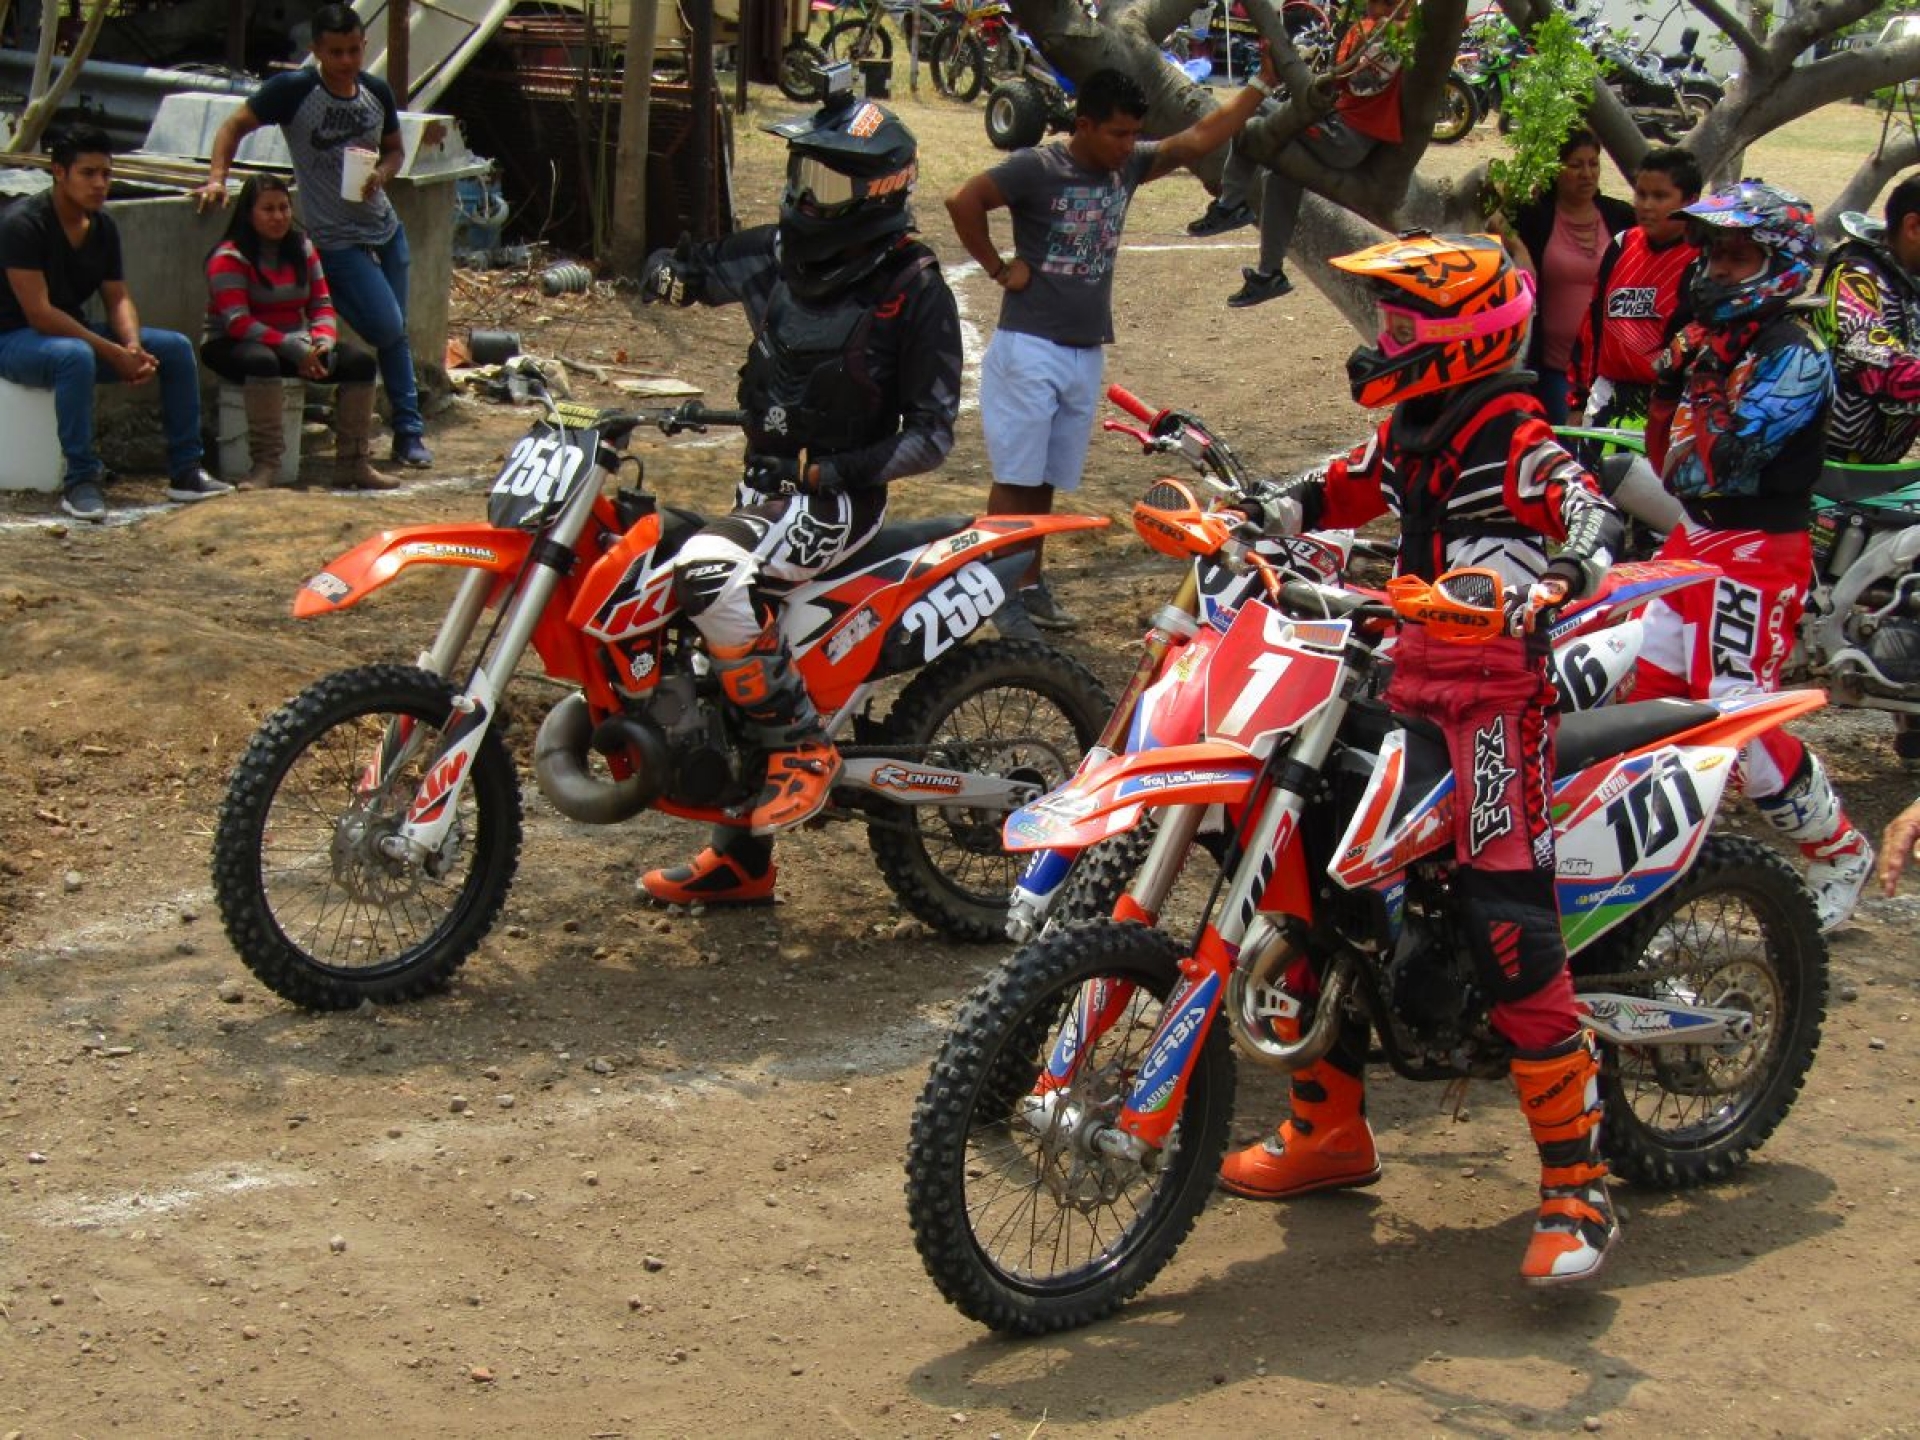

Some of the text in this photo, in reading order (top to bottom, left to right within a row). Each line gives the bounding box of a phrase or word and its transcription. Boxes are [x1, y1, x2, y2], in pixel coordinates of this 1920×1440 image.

[492, 437, 584, 503] 259
[950, 531, 981, 551] 250
[684, 562, 727, 579] FOX
[902, 561, 1005, 662] 259
[1417, 607, 1491, 626] ACERBIS
[1713, 579, 1758, 683] FOX
[1216, 651, 1294, 737] 1
[1599, 771, 1631, 803] KEVIN
[1606, 751, 1706, 876] 101
[1557, 857, 1594, 876] KTM
[1588, 883, 1637, 904] MOTOREX
[1132, 1007, 1206, 1098] ACERBIS
